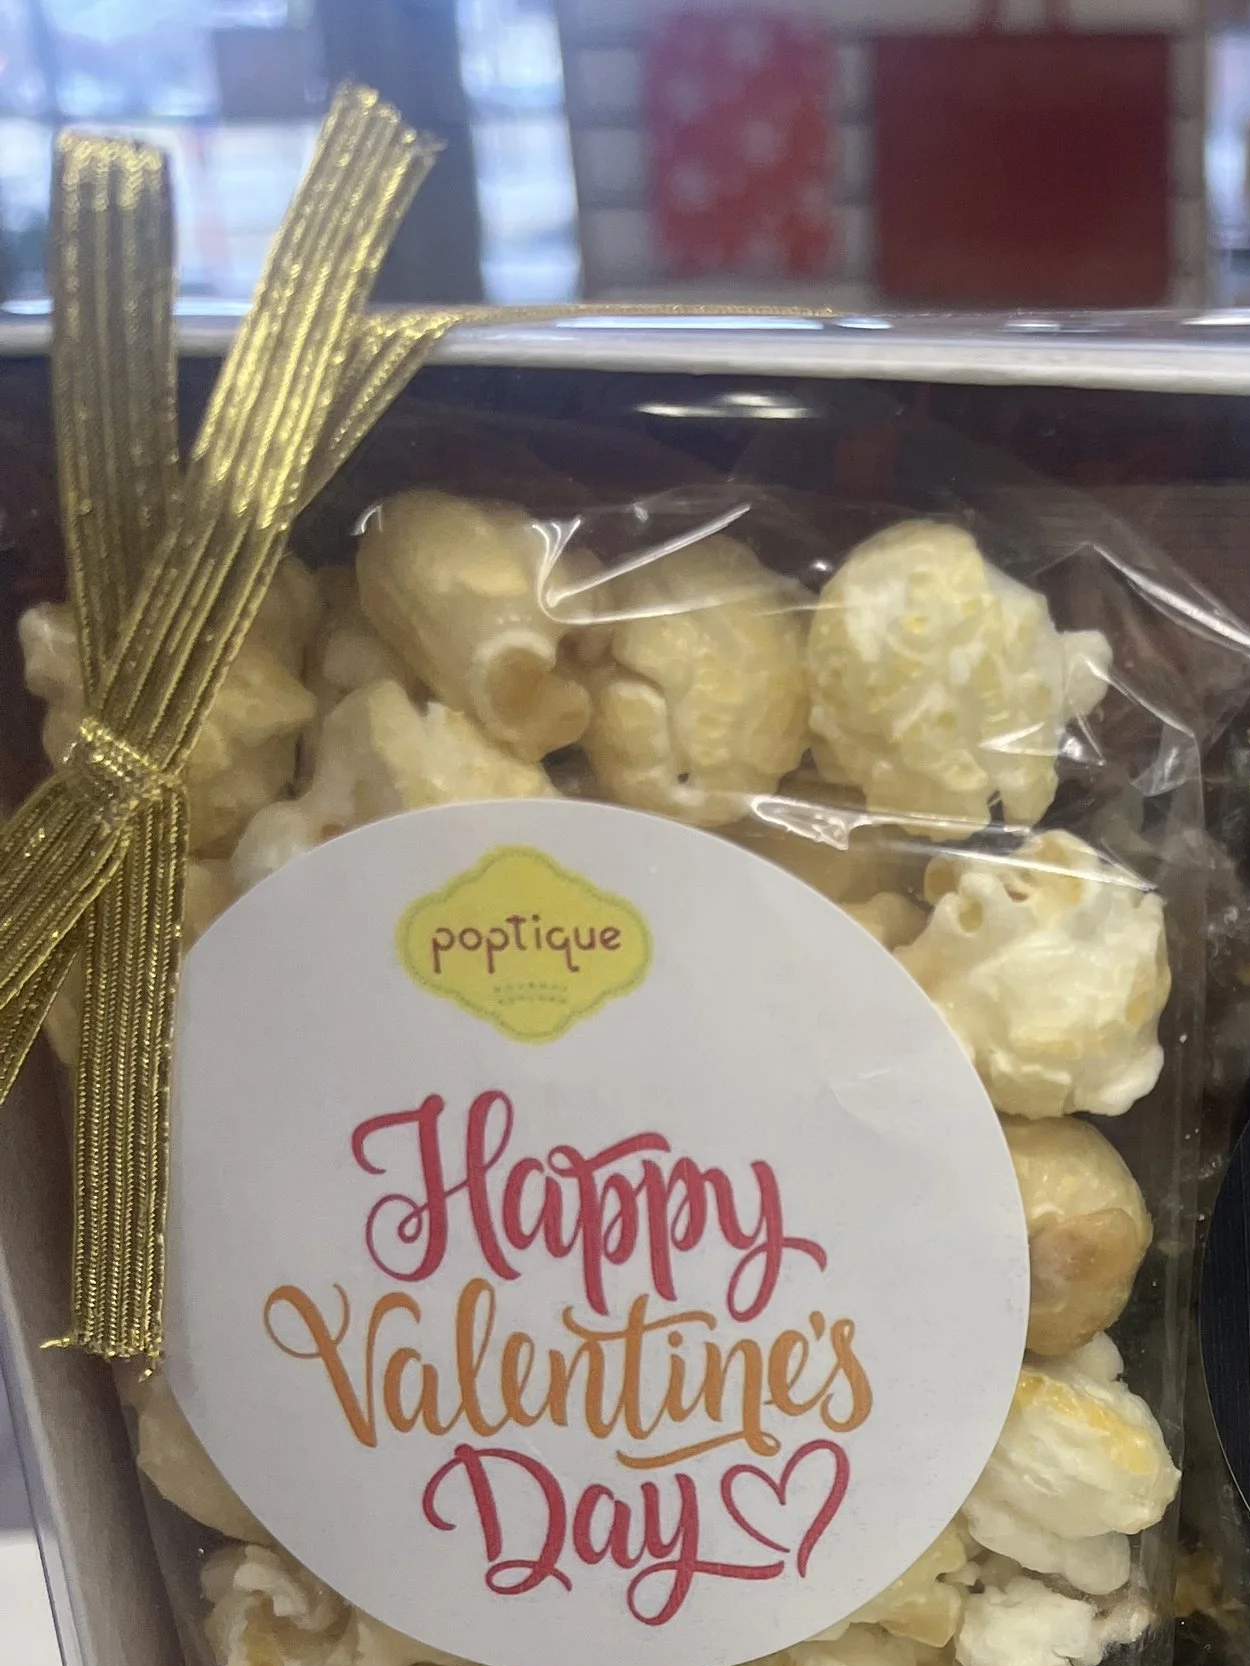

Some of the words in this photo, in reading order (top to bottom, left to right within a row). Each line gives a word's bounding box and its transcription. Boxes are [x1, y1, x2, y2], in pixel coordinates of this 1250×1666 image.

[432, 914, 622, 974] poptique
[351, 1089, 828, 1322] Happy
[263, 1278, 873, 1469] Valentine's
[422, 1445, 785, 1626] Day
